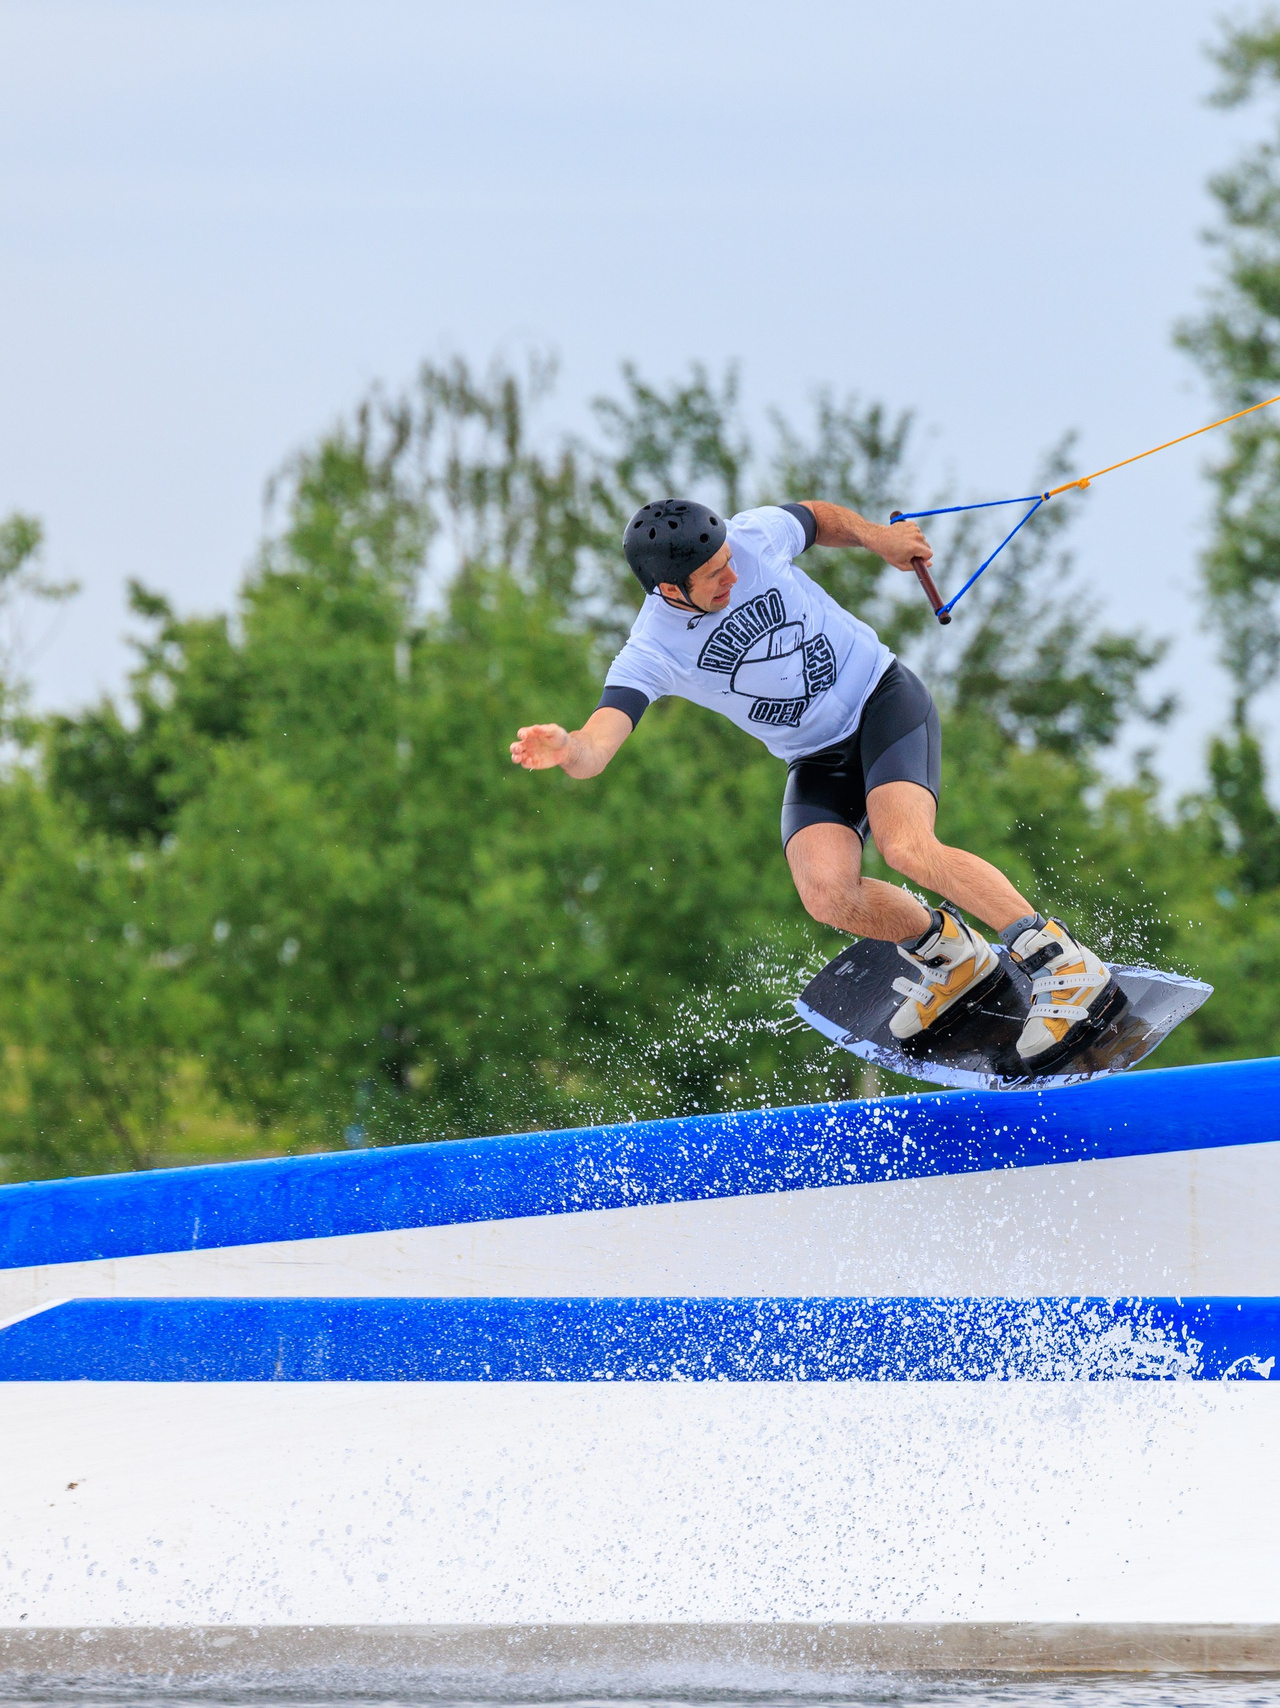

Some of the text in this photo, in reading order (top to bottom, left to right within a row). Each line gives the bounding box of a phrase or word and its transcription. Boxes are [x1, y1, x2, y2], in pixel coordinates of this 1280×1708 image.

[701, 591, 784, 672] KUPCHINO
[804, 637, 835, 695] 2025
[752, 700, 805, 724] OPEN
